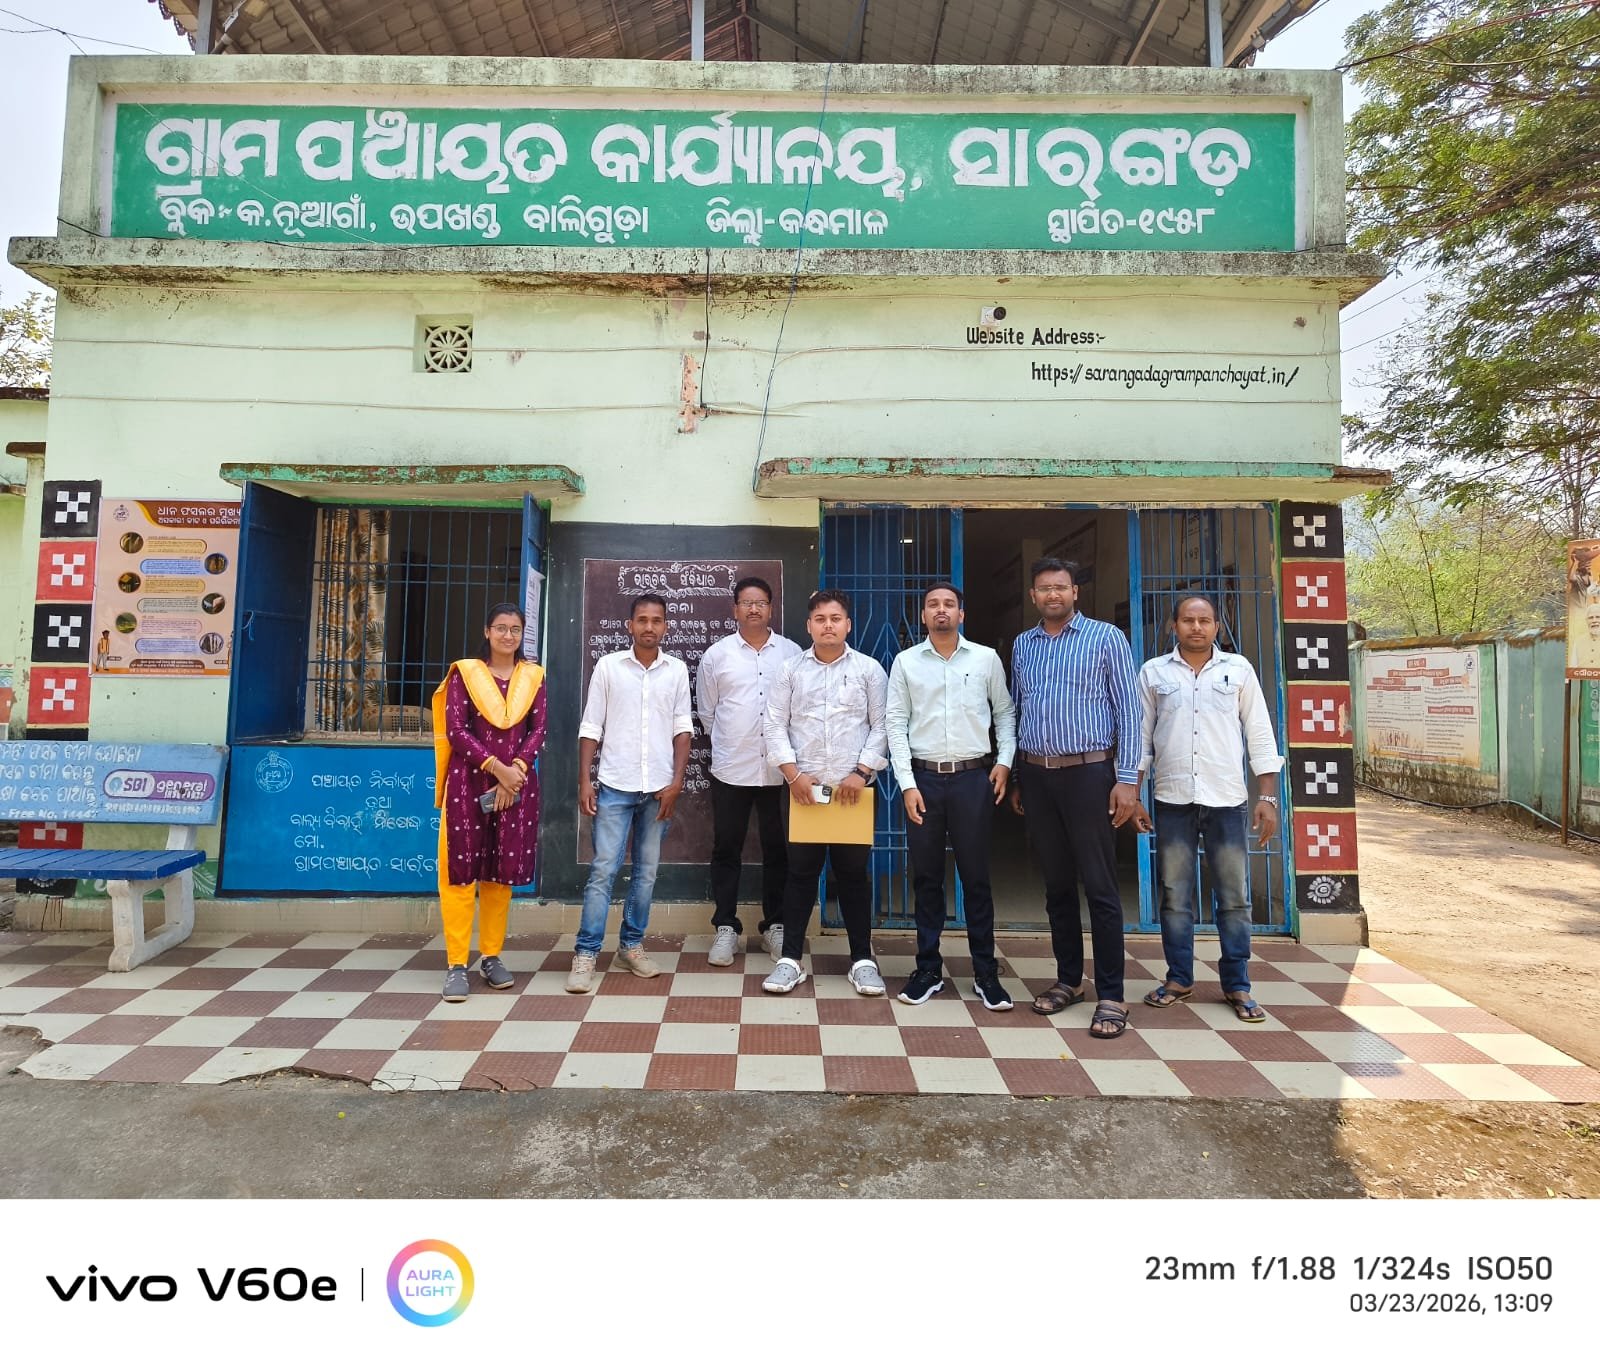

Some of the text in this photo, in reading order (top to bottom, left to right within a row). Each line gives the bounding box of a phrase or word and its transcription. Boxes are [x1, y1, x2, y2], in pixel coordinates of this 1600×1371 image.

[146, 118, 280, 199] ଗ୍ରାମ
[967, 327, 1024, 345] Website
[123, 777, 208, 796] SBI general
